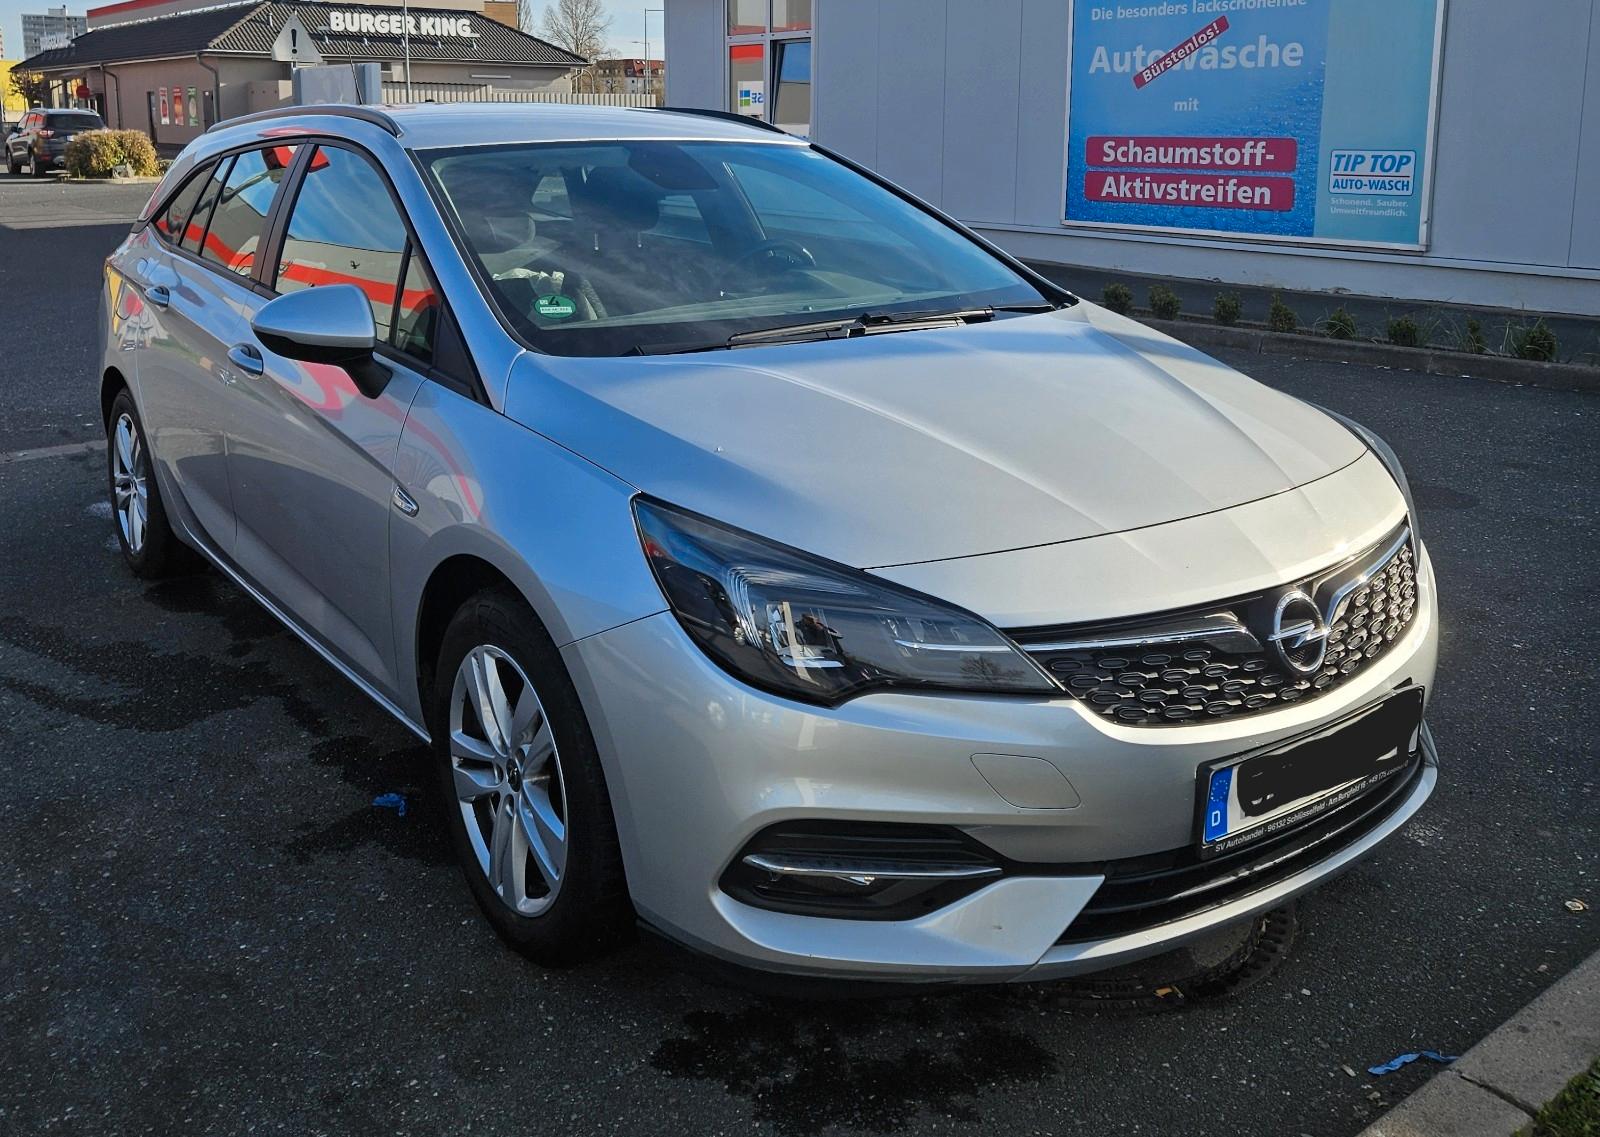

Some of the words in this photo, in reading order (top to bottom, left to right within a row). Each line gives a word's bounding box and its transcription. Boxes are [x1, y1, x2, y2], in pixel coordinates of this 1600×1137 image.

[1091, 8, 1113, 21] Die
[1116, 3, 1188, 19] besonders
[330, 11, 417, 34] BURGER
[420, 16, 480, 37] KING
[1142, 22, 1220, 83] Bürstenlos!
[1174, 98, 1200, 112] mit
[1102, 140, 1275, 166] Schaumstoff-
[1333, 154, 1366, 172] TIP
[1370, 154, 1411, 173] TOP
[1101, 175, 1271, 205] Aktivstreifen
[1332, 178, 1410, 191] AUTO-WASCH
[1376, 199, 1409, 208] Sauber.
[1211, 810, 1220, 827] D
[1215, 842, 1226, 852] SV
[1226, 827, 1264, 849] Autohandel
[1267, 818, 1286, 833] 96132
